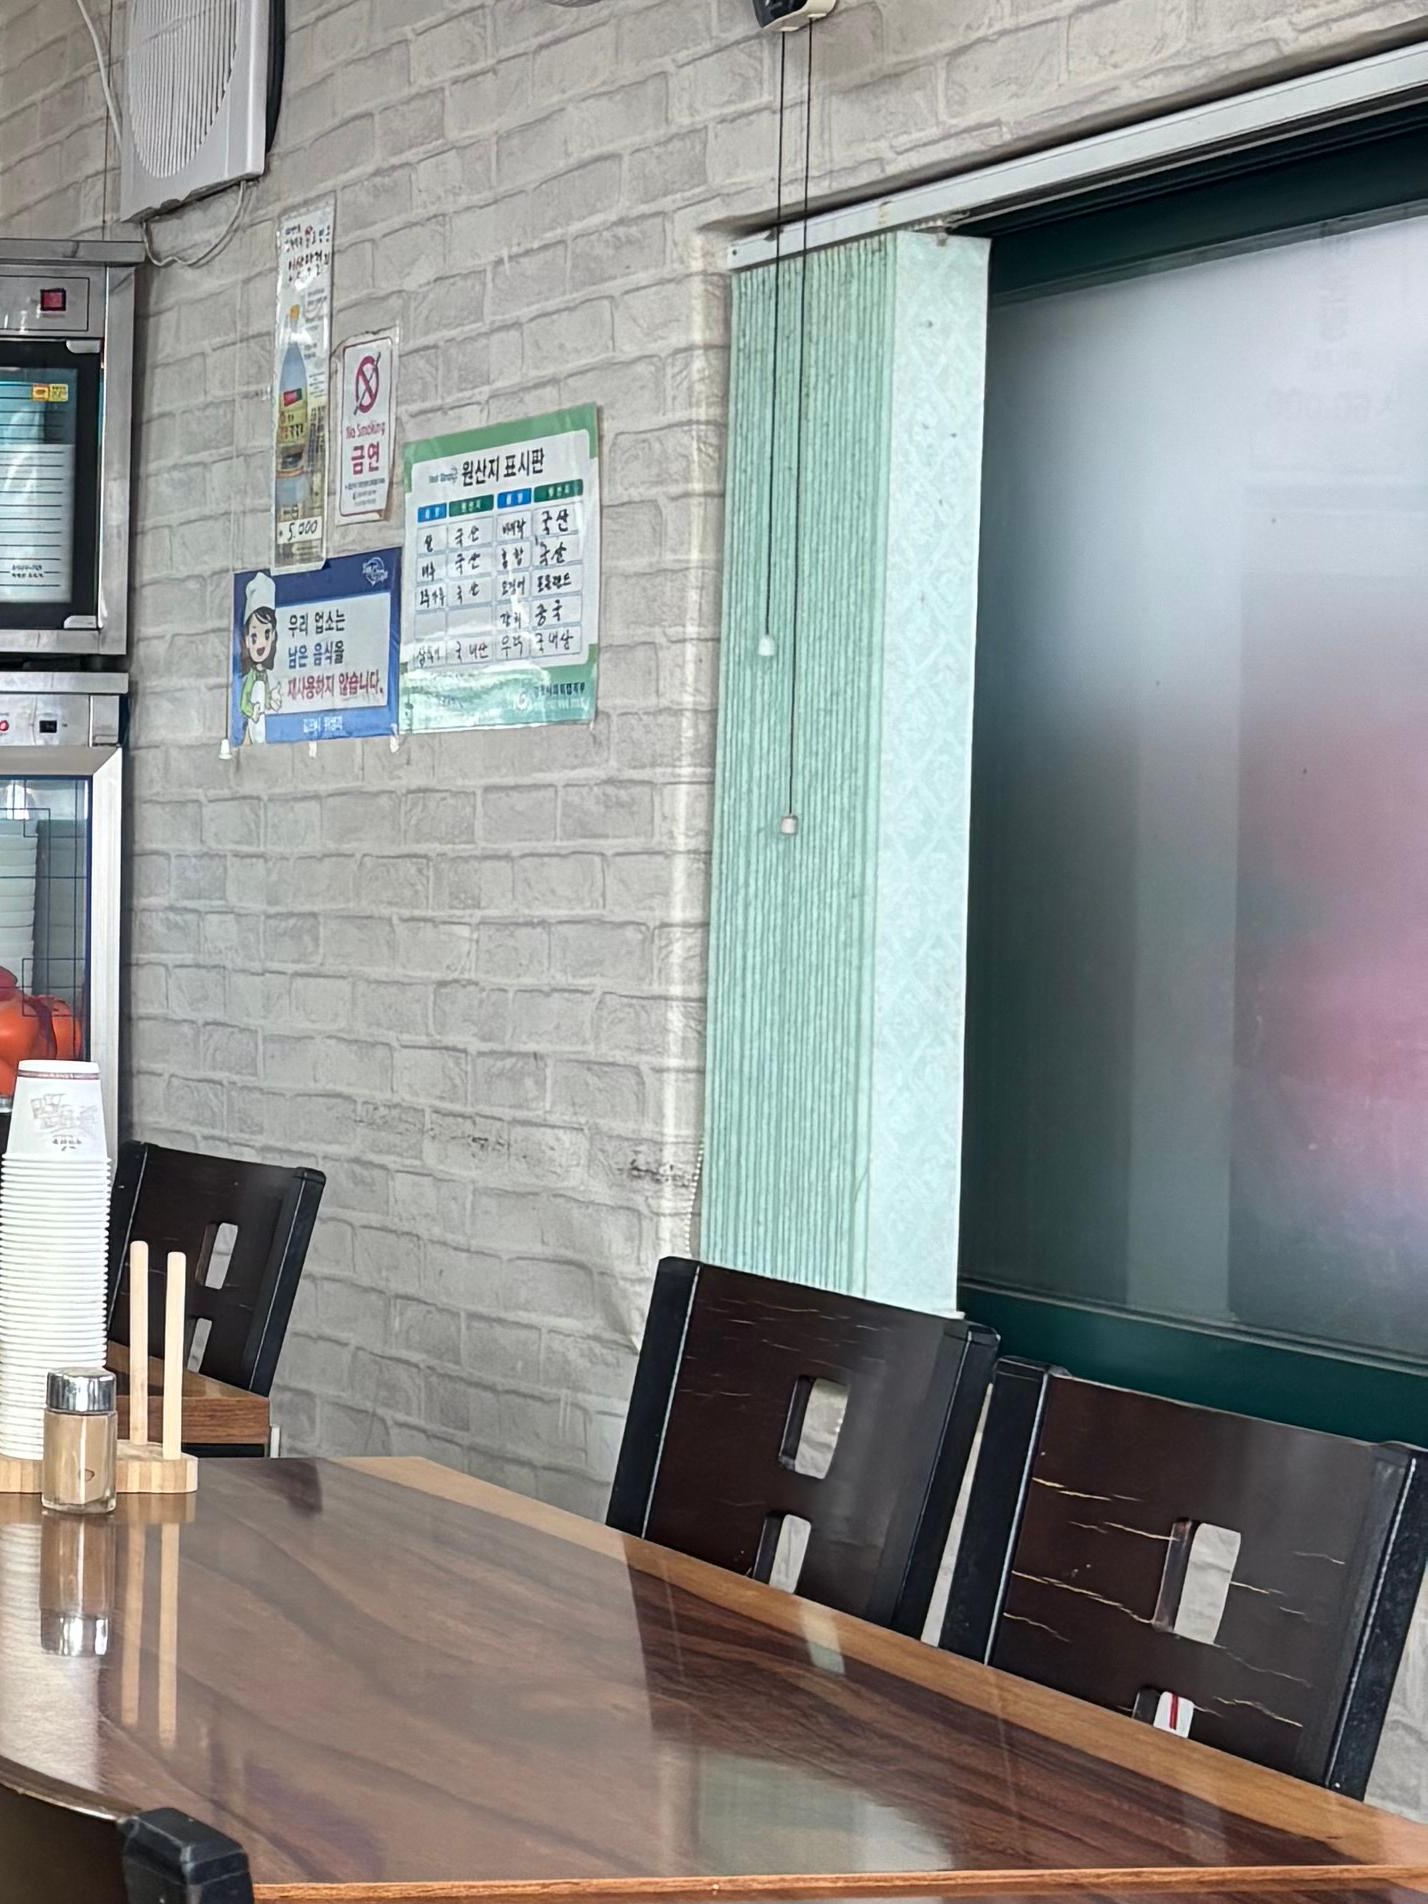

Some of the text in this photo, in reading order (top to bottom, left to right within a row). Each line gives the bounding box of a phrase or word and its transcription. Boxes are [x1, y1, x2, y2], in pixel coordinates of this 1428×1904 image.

[351, 441, 380, 475] 금연
[461, 456, 500, 487] 원산지
[503, 447, 545, 478] 표시판
[288, 609, 346, 638] 우리 업소는
[288, 640, 345, 670] 남은 음식을
[287, 671, 335, 701] 재사용하지
